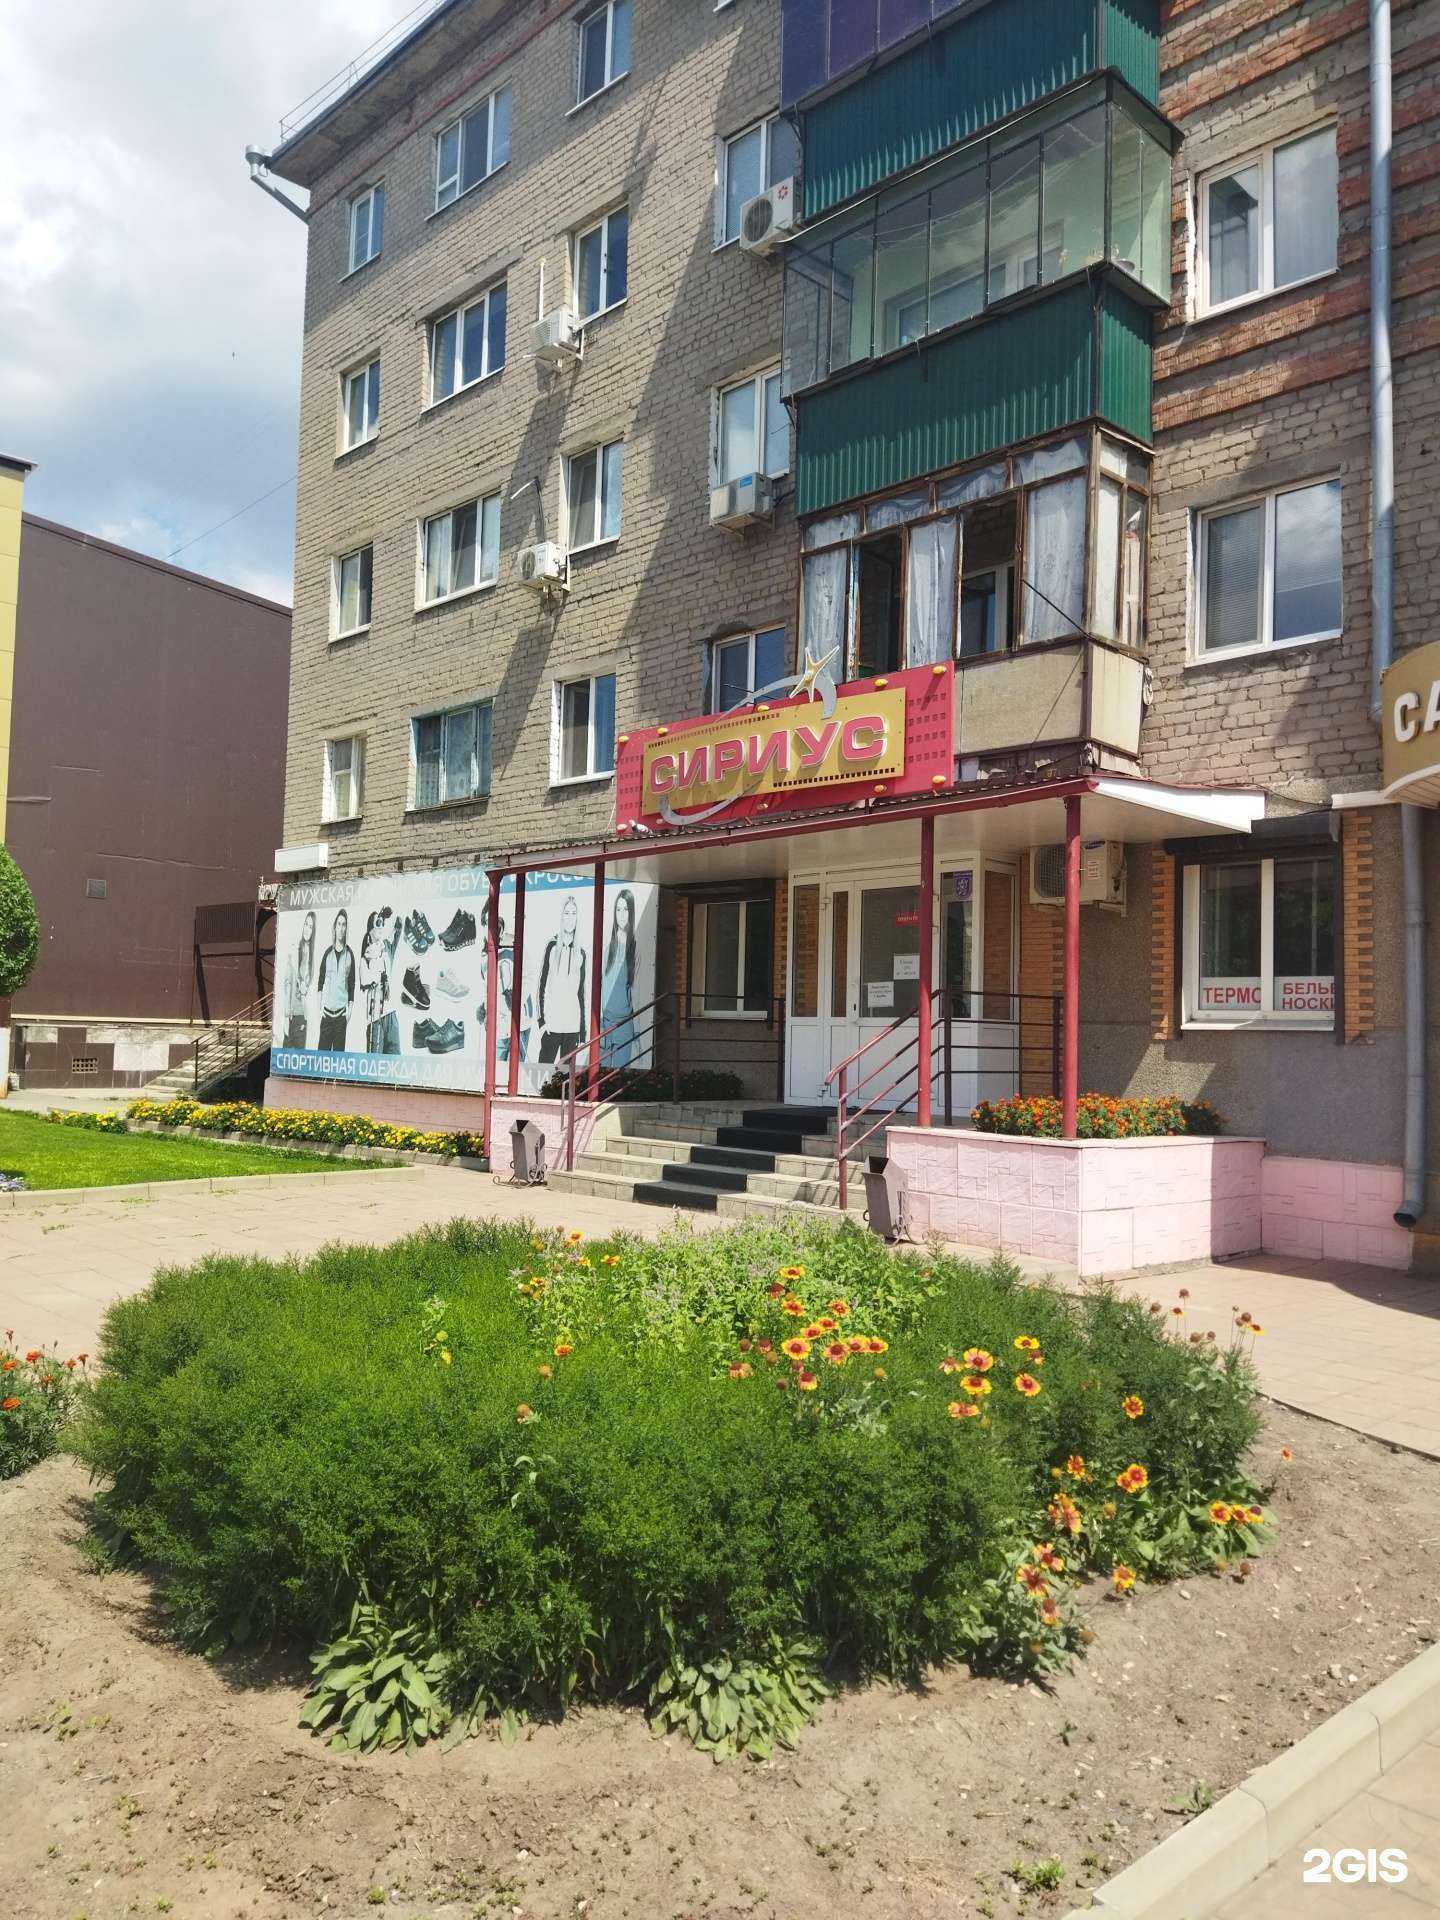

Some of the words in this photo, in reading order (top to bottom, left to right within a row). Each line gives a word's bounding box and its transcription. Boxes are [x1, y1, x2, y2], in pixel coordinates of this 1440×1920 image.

[650, 715, 888, 795] СИРИУС
[290, 884, 354, 906] МУЖСКАЯ
[447, 868, 503, 892] ОБУВ
[276, 1053, 356, 1075] СПОРТИВНАЯ
[359, 1059, 417, 1079] ОДЕЖДА
